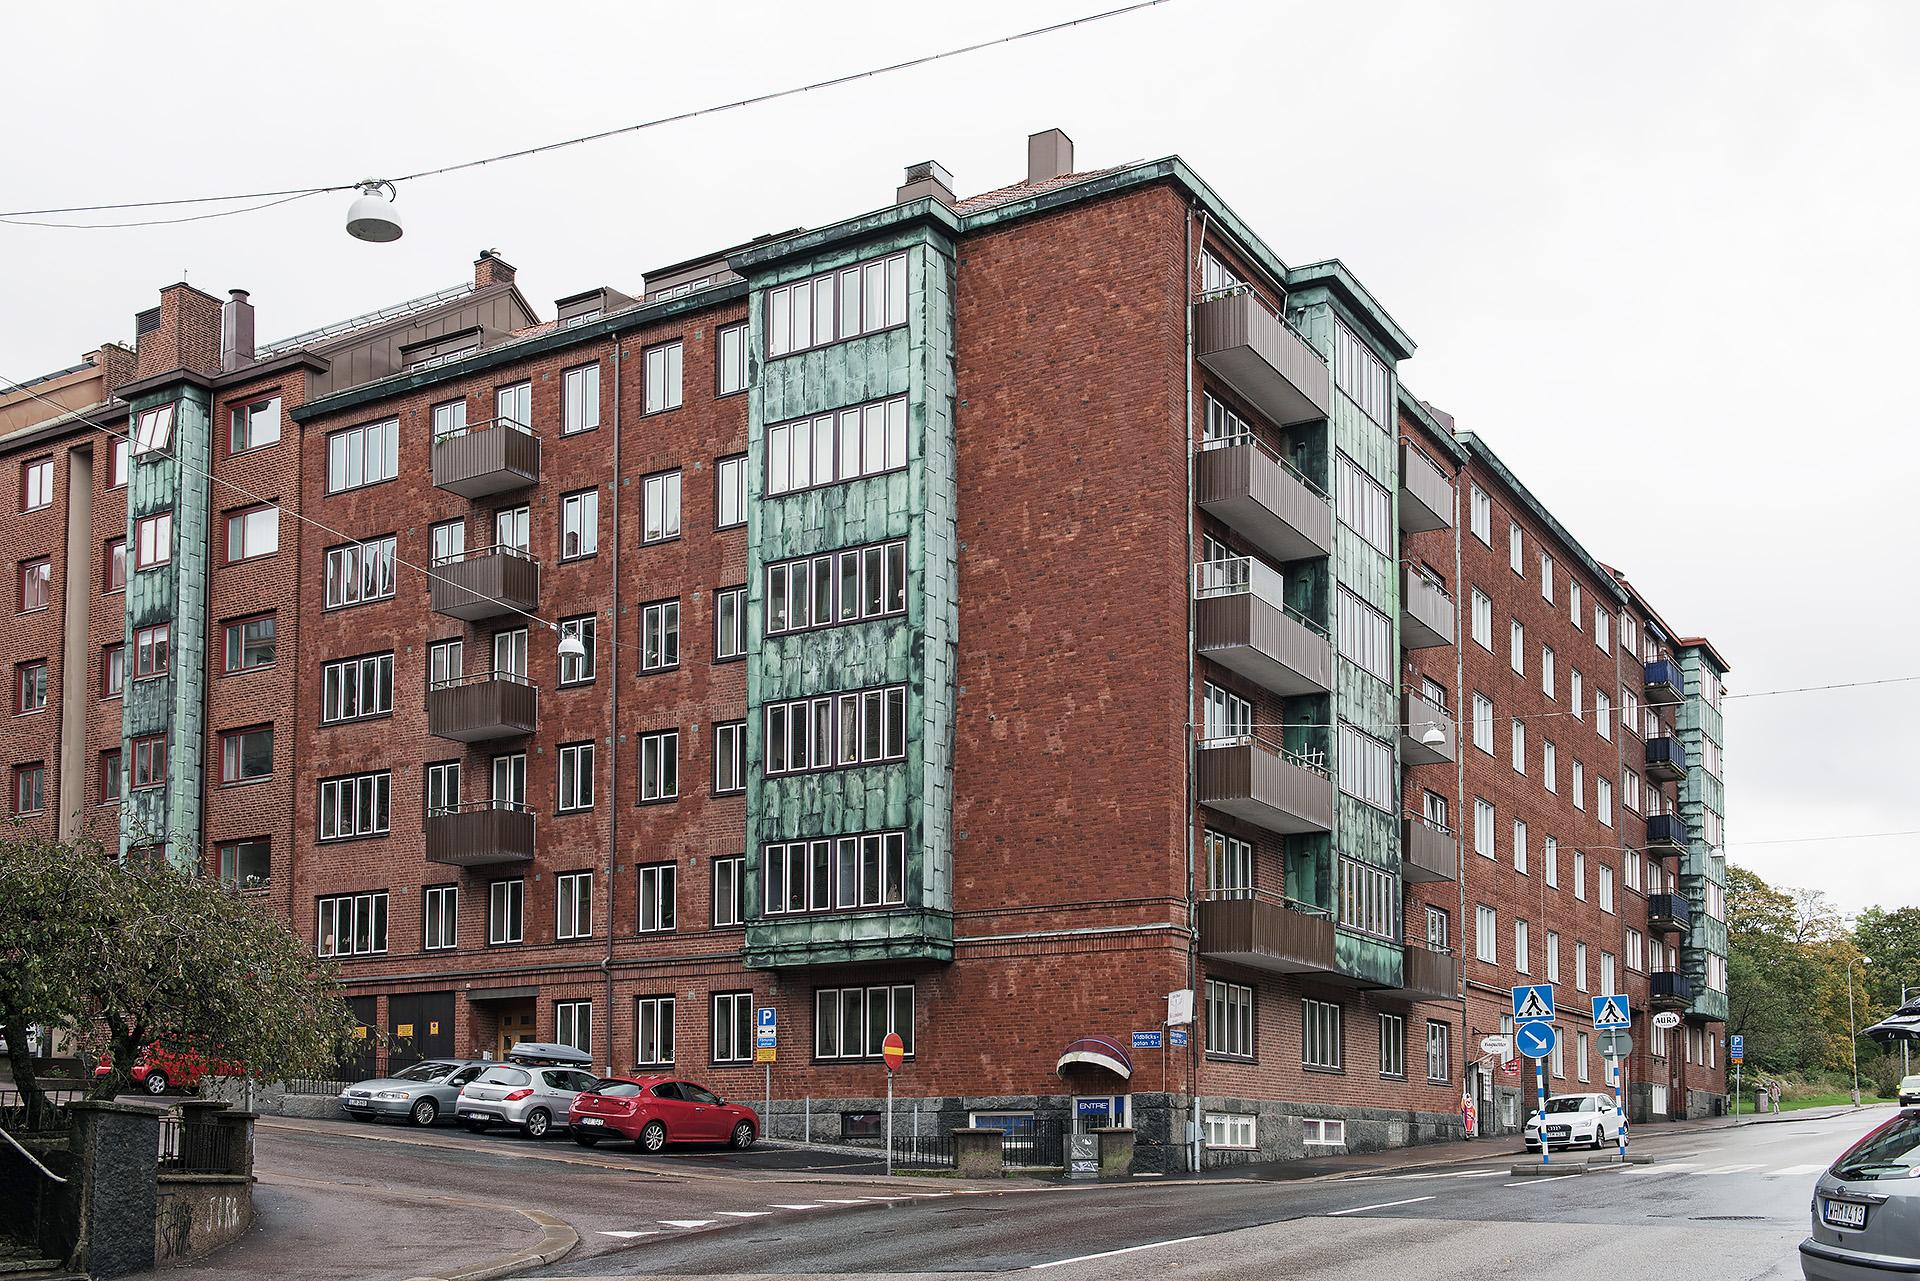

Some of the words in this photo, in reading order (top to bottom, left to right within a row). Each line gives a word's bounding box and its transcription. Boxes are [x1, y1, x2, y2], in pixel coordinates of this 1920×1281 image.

[763, 1010, 772, 1025] P
[1655, 1016, 1677, 1024] AURA
[1734, 1036, 1741, 1046] P
[1829, 1202, 1843, 1219] WHM
[1848, 1205, 1863, 1222] 413
